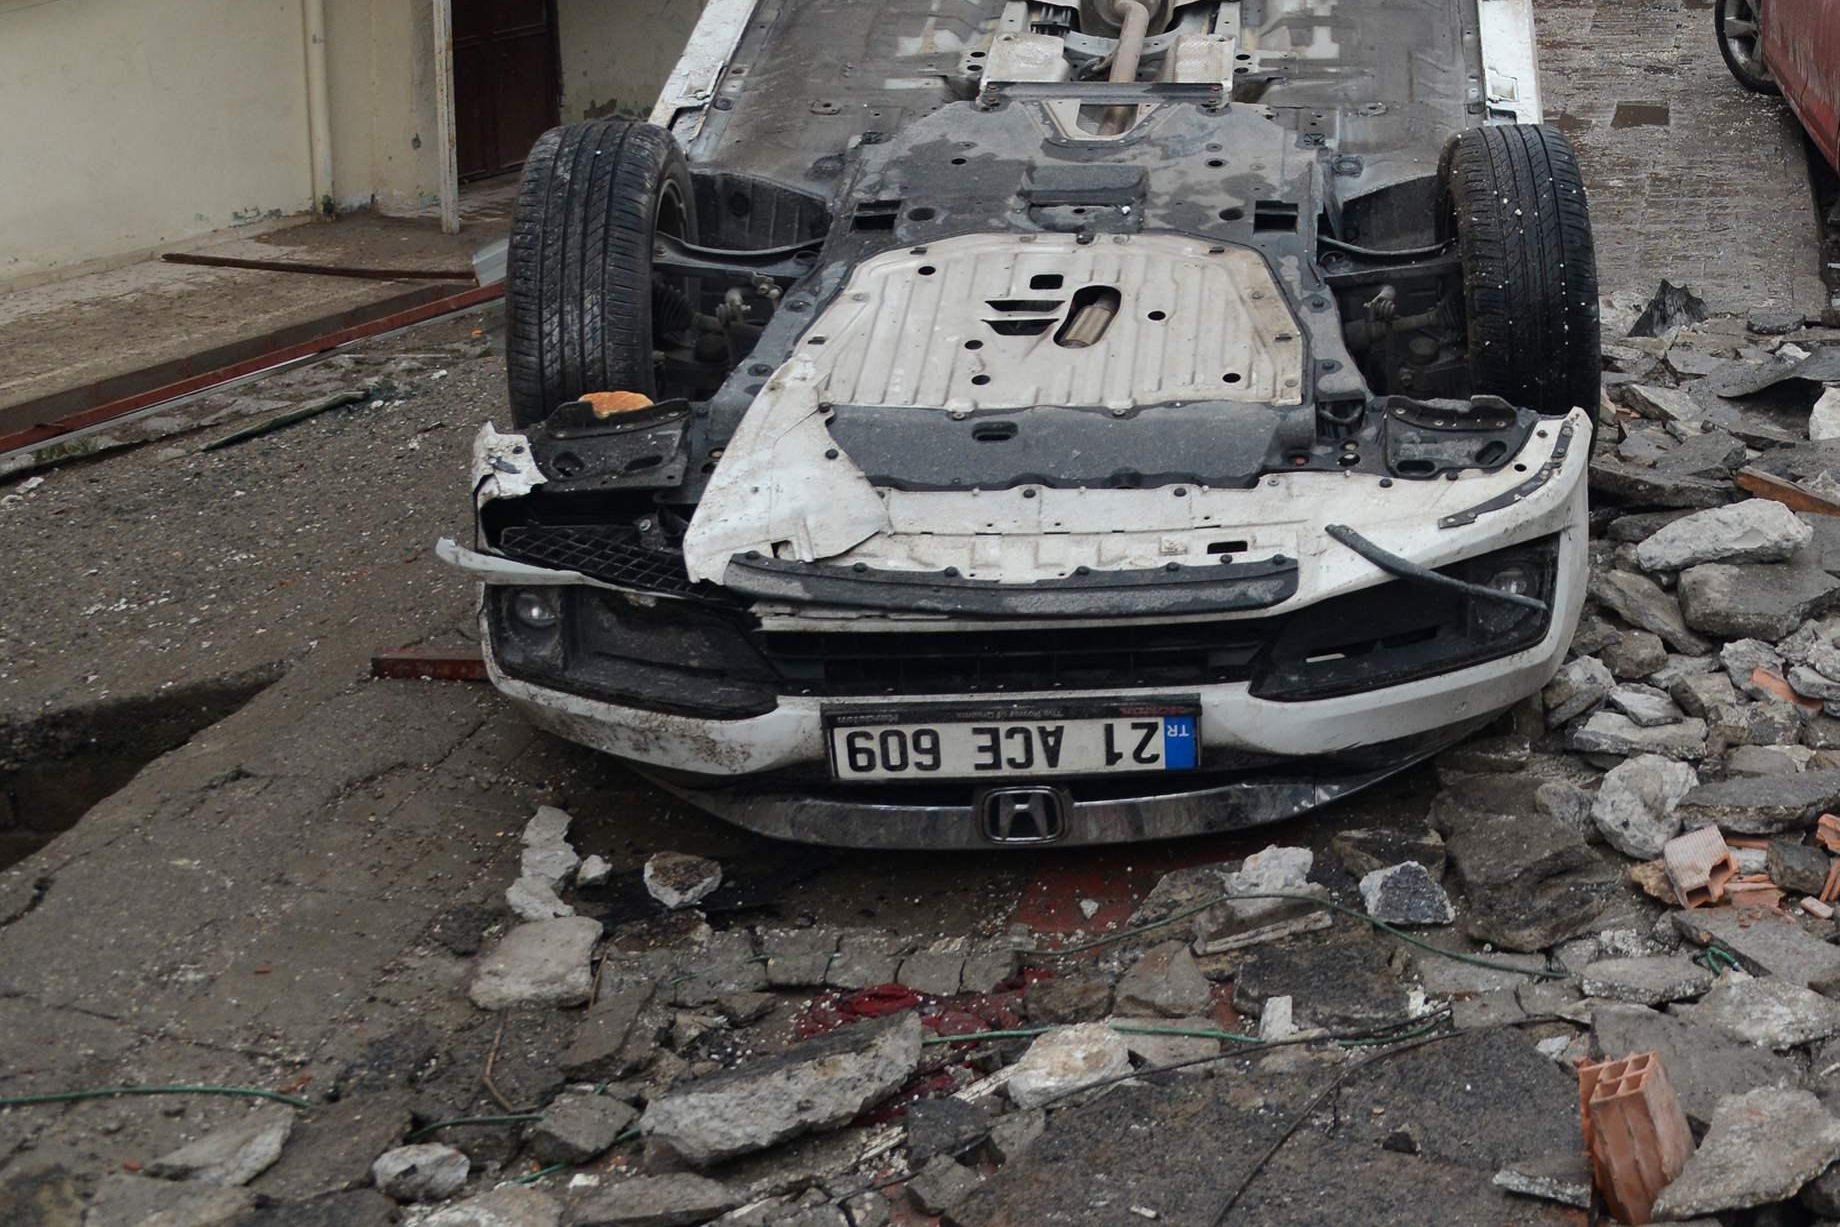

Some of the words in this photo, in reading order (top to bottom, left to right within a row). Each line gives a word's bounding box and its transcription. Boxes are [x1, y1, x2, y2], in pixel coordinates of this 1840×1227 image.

[846, 728, 941, 772] 609
[972, 726, 1064, 770] ACE
[1104, 722, 1160, 766] 21
[1167, 725, 1189, 737] TR
